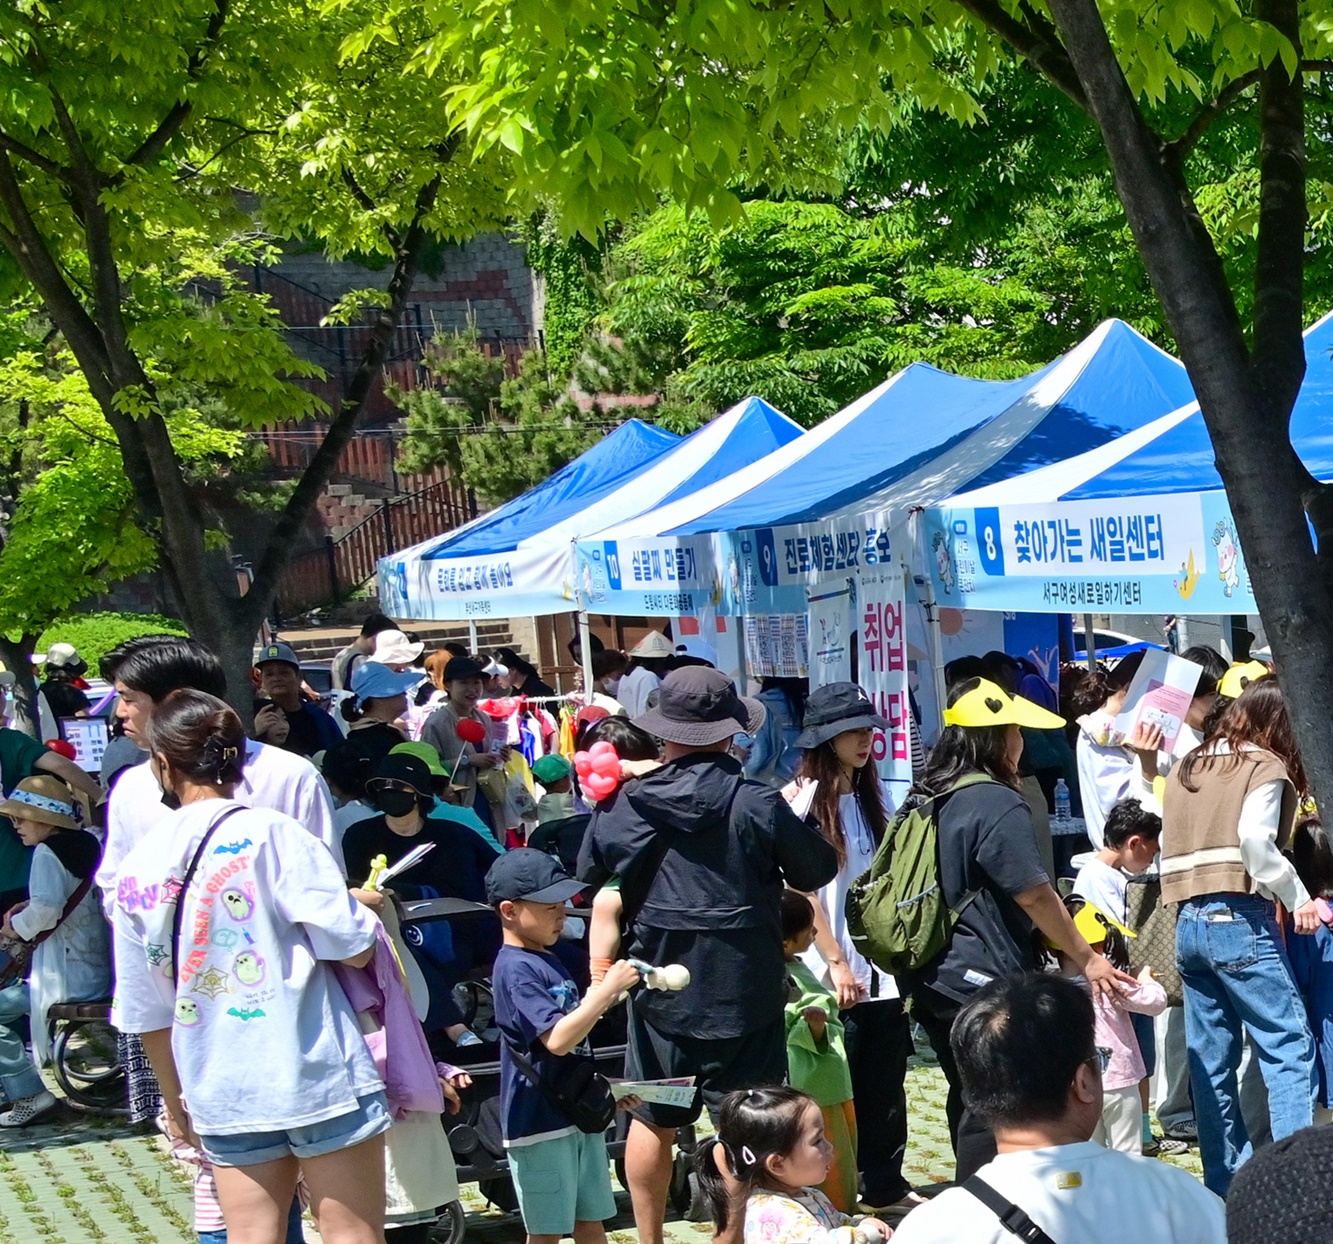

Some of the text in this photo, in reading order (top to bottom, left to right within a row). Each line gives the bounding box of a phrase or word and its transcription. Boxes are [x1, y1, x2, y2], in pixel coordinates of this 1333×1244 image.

[784, 531, 860, 574] 진로체험센터
[863, 528, 891, 565] 홍보
[984, 526, 997, 561] 8
[1014, 514, 1165, 563] 찾아가는 새일센터
[607, 555, 619, 580] 10
[665, 548, 697, 580] 만들기
[763, 544, 771, 573] 9
[1043, 580, 1142, 605] 서구여성새로일하기센터
[865, 600, 904, 672] 취업
[205, 857, 248, 895] GHOST
[200, 897, 214, 908] A
[194, 910, 211, 946] SEEN
